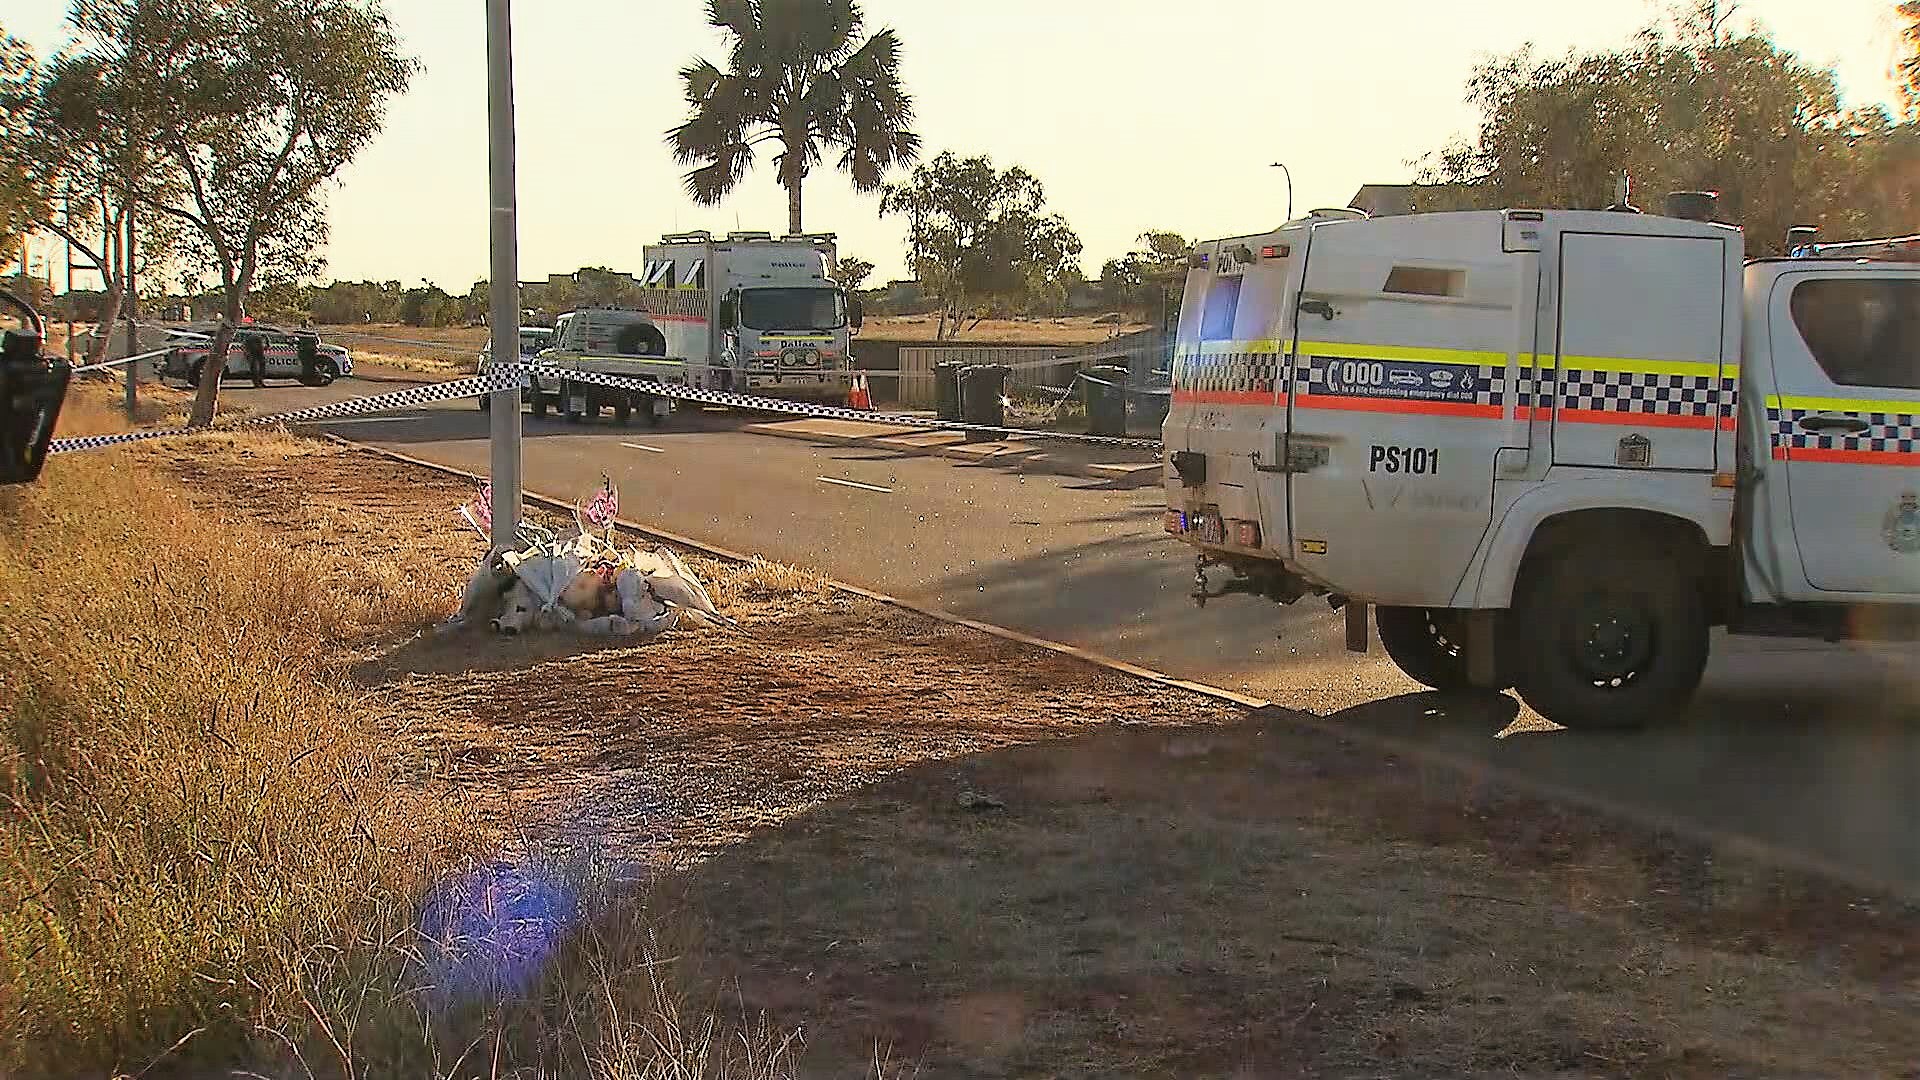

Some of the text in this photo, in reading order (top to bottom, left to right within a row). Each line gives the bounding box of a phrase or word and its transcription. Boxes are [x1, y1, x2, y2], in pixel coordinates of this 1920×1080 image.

[266, 357, 298, 366] OLICE
[1342, 361, 1384, 386] 000
[1369, 445, 1439, 475] PS101
